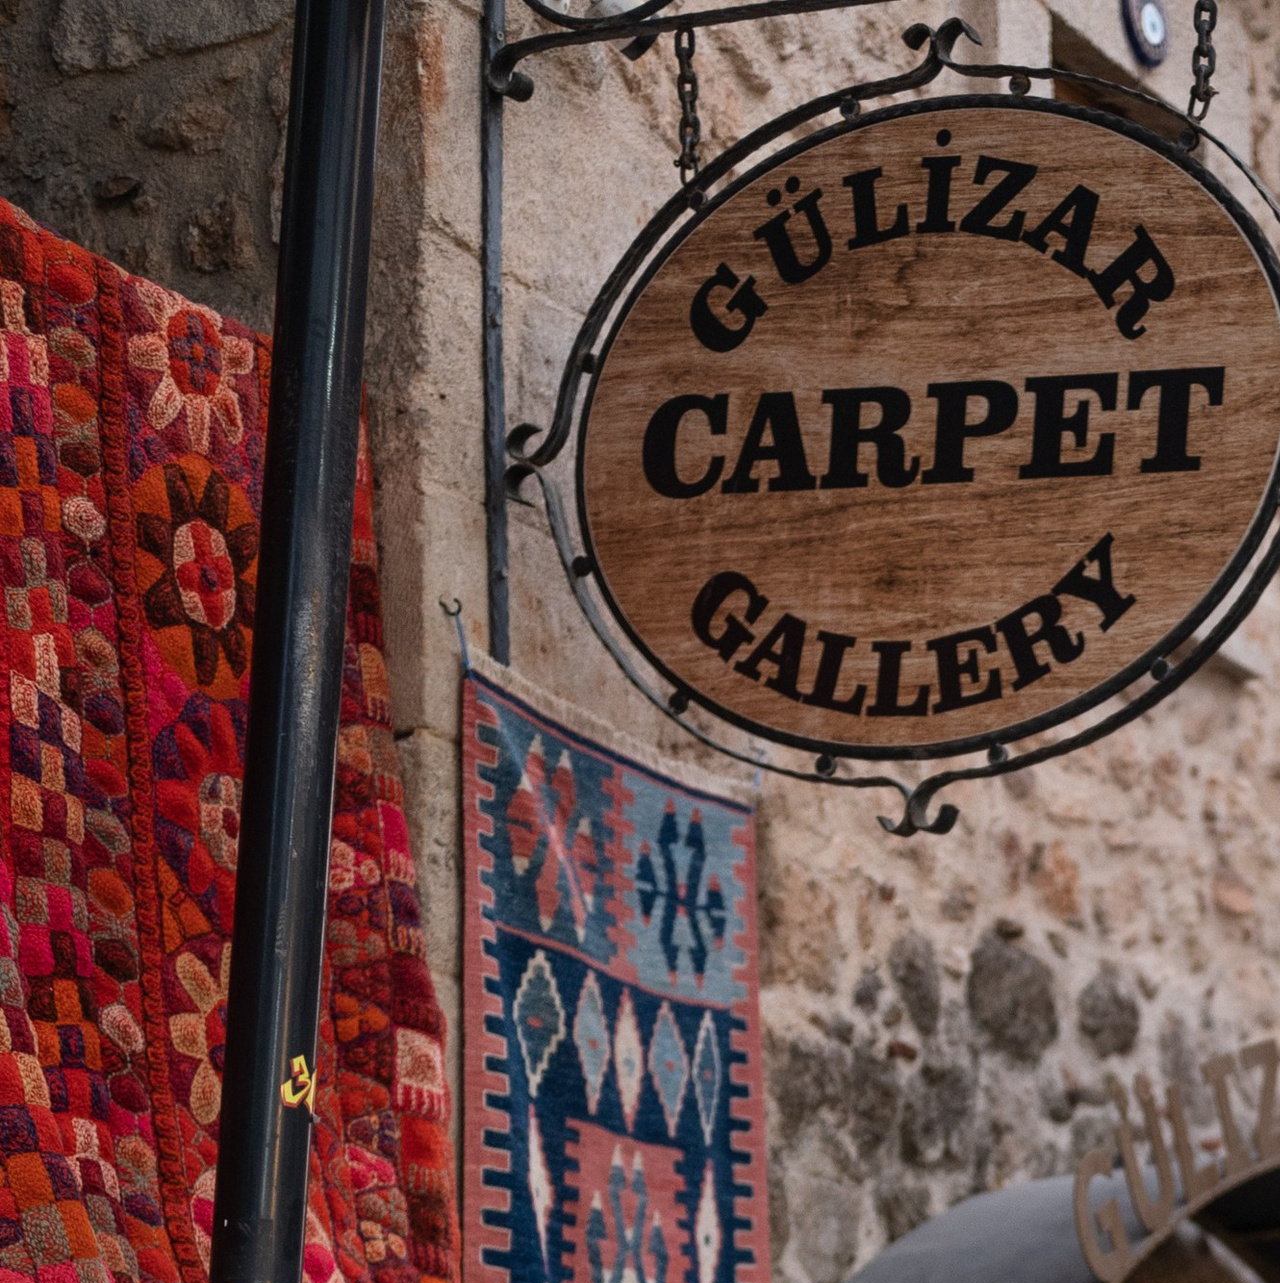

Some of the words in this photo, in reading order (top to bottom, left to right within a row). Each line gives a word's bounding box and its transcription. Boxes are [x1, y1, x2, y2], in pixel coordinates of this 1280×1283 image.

[688, 129, 1177, 354] GÜLİZAR
[641, 366, 1226, 500] CARPET
[691, 533, 1137, 718] GALLERY
